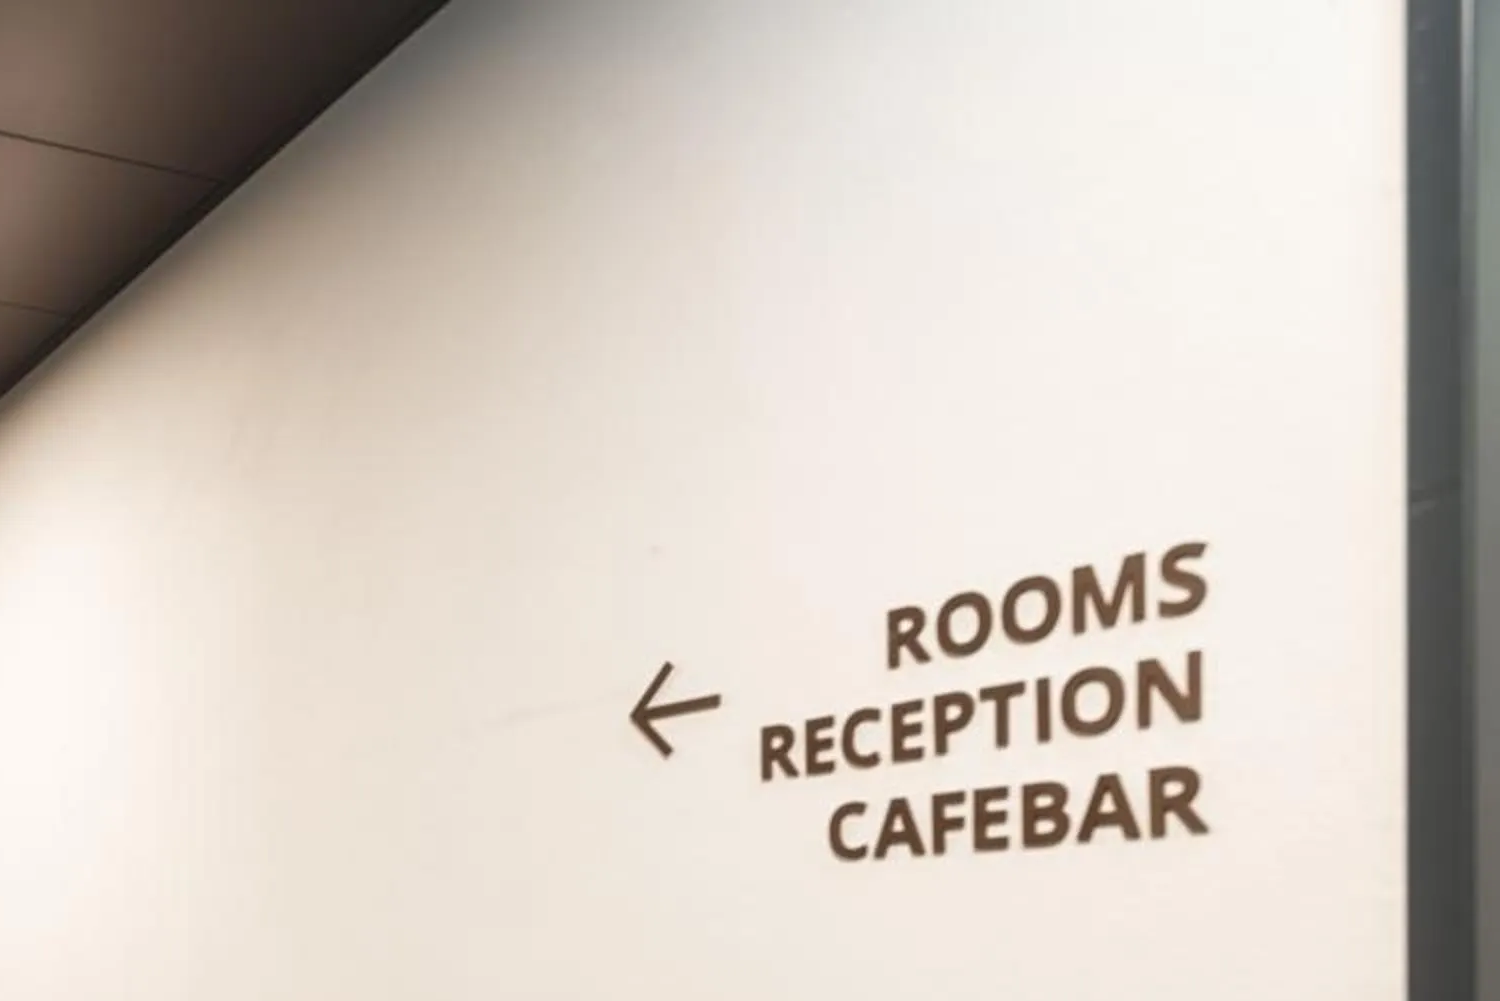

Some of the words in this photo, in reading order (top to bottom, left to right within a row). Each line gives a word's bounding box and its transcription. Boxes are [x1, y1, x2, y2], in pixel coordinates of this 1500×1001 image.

[886, 541, 1209, 671] ROOMS
[760, 650, 1204, 783] RECEPTION
[828, 765, 1211, 862] CAFEBAR
